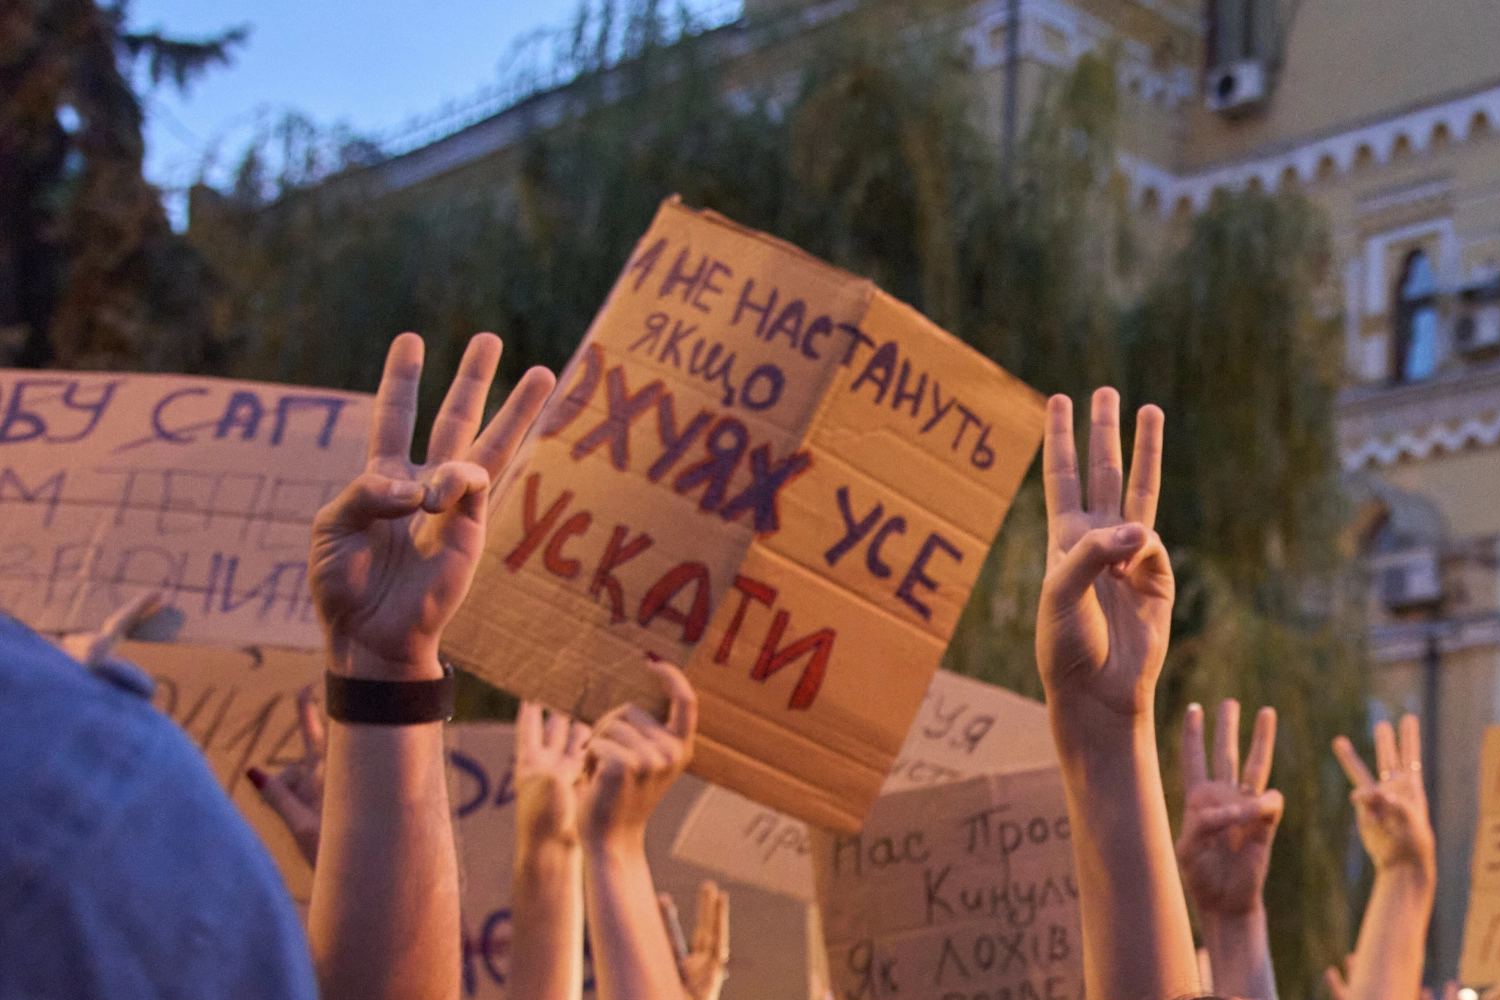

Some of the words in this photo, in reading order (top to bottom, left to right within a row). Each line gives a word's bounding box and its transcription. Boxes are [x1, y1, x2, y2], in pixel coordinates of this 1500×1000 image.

[0, 378, 123, 445] БУ
[146, 385, 348, 450] САП
[626, 312, 787, 412] ЯКЩО
[729, 278, 997, 472] НАСТАНУТЬ
[95, 465, 347, 552] ТЕПЕ
[823, 487, 964, 622] УСЕ
[504, 472, 837, 712] УСКАТИ
